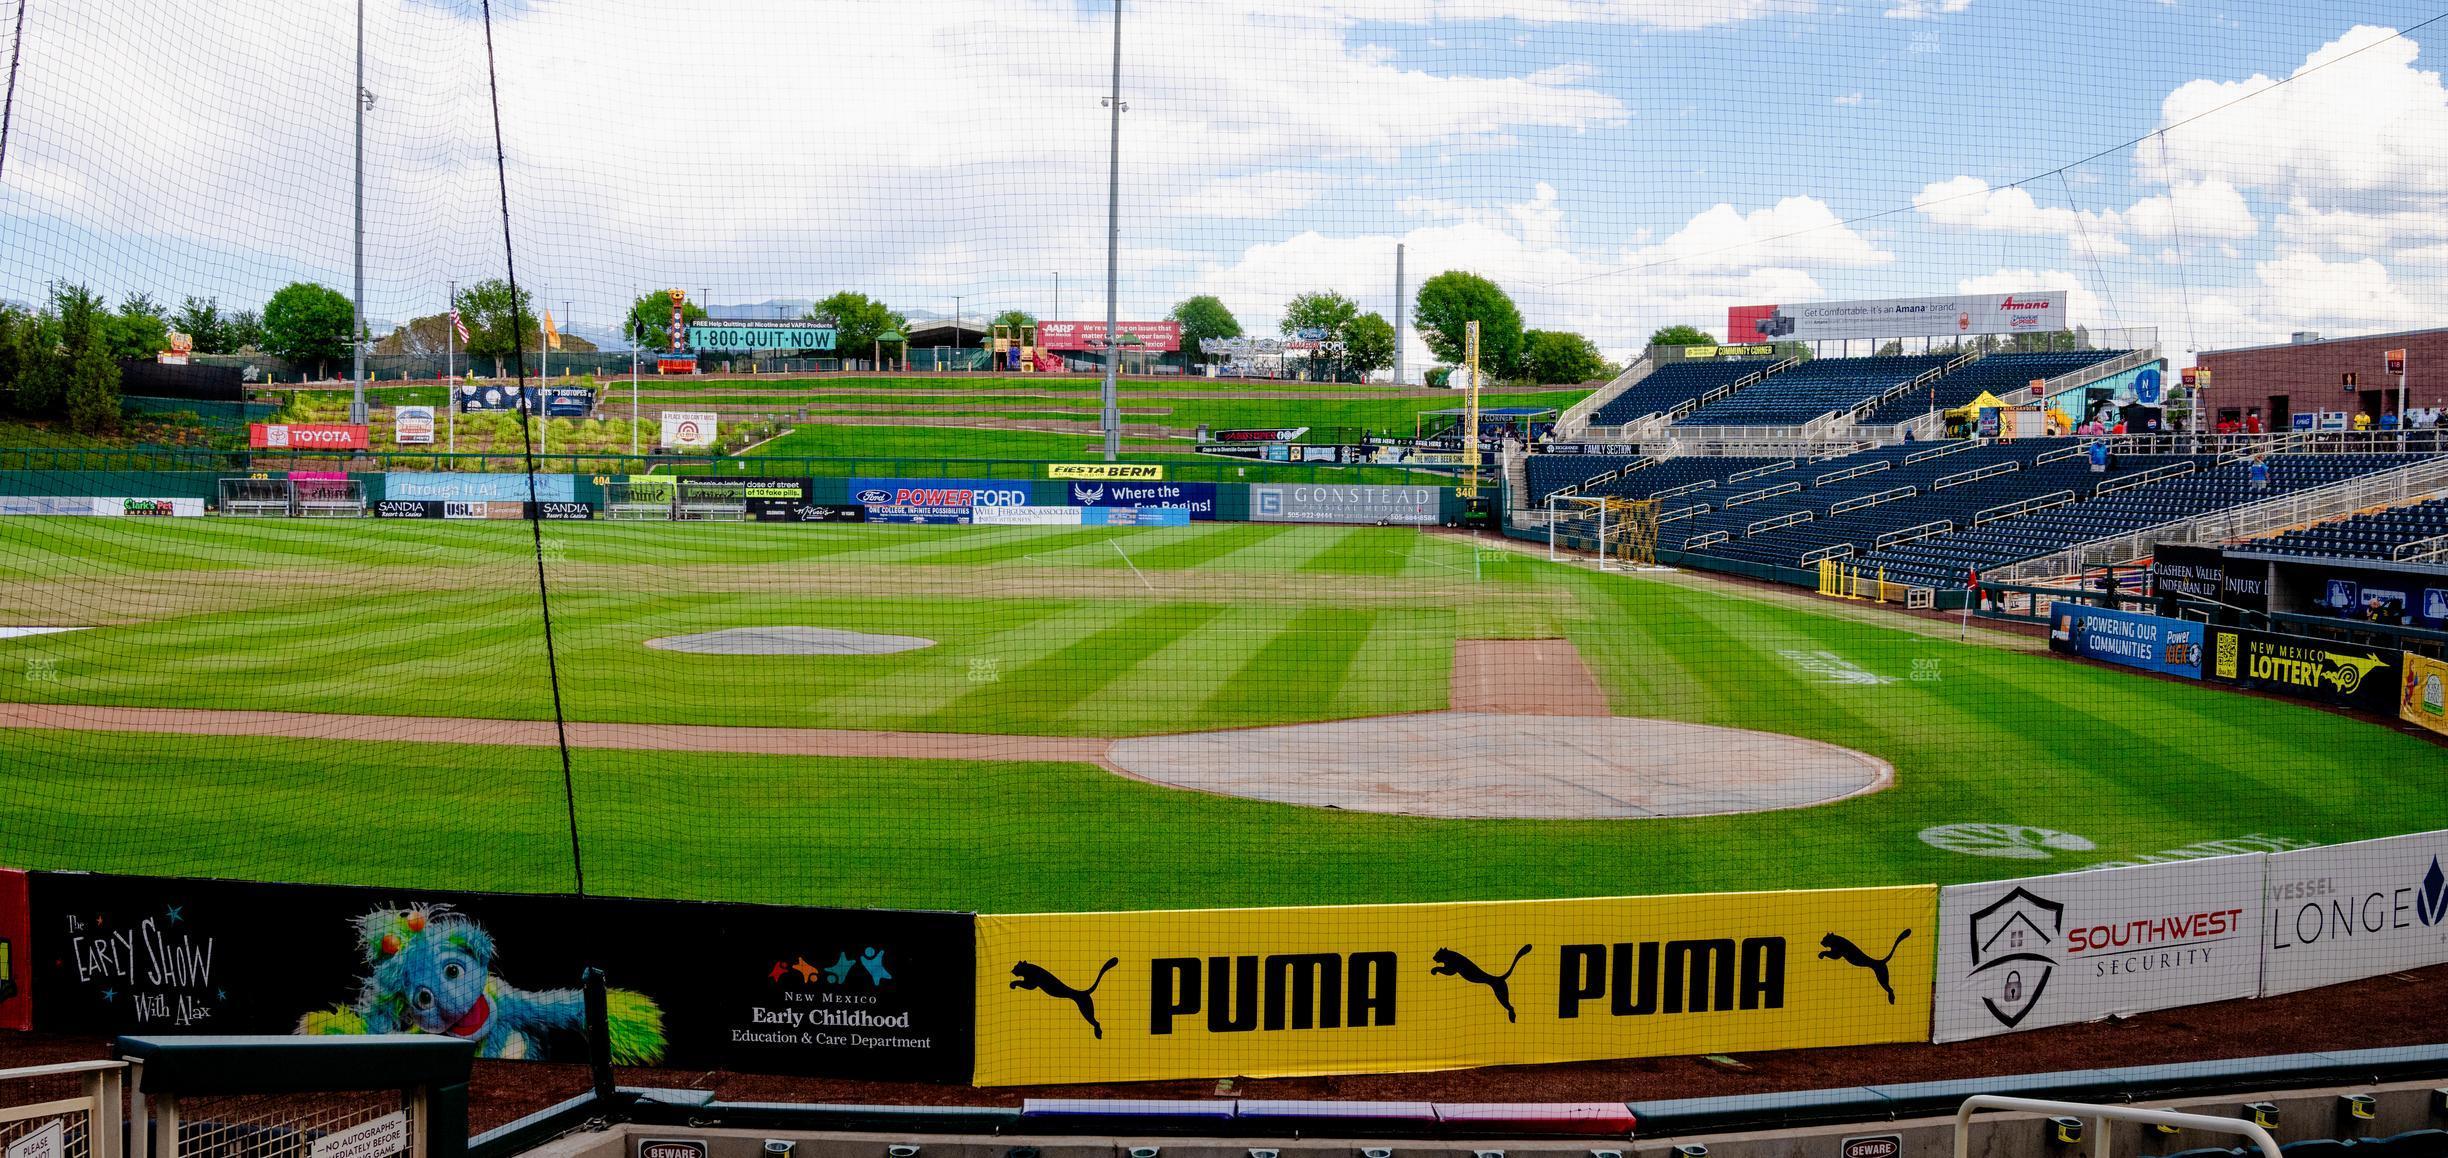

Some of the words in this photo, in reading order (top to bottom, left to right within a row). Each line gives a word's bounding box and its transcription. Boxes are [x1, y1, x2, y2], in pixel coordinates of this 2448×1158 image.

[1804, 309, 1817, 317] Get
[1819, 306, 1868, 317] Comfortable.
[1870, 305, 1882, 314] It's
[1884, 306, 1894, 314] an
[1930, 302, 1956, 312] brand.
[2000, 296, 2049, 310] Amana
[709, 320, 722, 328] Help
[723, 320, 746, 328] Quitting
[1042, 324, 1074, 333] AARP
[1084, 324, 1101, 332] We're
[1138, 324, 1156, 332] issues
[1158, 324, 1171, 332] that
[1320, 341, 1348, 350] FORD
[1718, 346, 1750, 355] COMMUNITY
[1750, 346, 1772, 355] CORNER
[2142, 379, 2149, 389] N
[1485, 414, 1513, 422] CORNER
[292, 431, 351, 442] TOYOTA
[1584, 444, 1606, 455] FAMILY
[1606, 444, 1631, 455] SECTION
[1414, 454, 1423, 463] THE
[1424, 454, 1439, 463] MODEL
[1440, 454, 1451, 463] BEER
[1108, 467, 1157, 477] BERM
[592, 476, 610, 486] 404
[747, 480, 766, 488] dose
[767, 480, 776, 488] of
[400, 483, 459, 497] Through
[464, 483, 473, 496] It
[479, 483, 499, 496] All
[862, 491, 885, 502] Ford
[896, 488, 973, 506] POWER
[973, 490, 1025, 507] FORD
[1112, 487, 1155, 500] Where
[1158, 485, 1180, 498] the
[1294, 487, 1429, 505] GONSTEAD
[1455, 488, 1474, 498] 340
[124, 499, 155, 509] Clark's
[157, 500, 173, 509] Pet
[379, 502, 424, 511] SANDIA
[543, 503, 589, 513] SANDIA
[974, 507, 993, 515] WILL
[998, 507, 1035, 516] FERGUSON
[2153, 562, 2194, 578] GLASHEEN,
[2196, 565, 2222, 581] VALLES
[2159, 577, 2202, 594] INDERMAN,
[2203, 583, 2216, 595] LLP
[2225, 576, 2261, 595] INJURY
[2087, 615, 2135, 637] POWERING
[2137, 623, 2157, 641] OUR
[2166, 630, 2190, 644] Power
[2089, 635, 2152, 660] COMMUNITIES
[2165, 643, 2188, 665] KICK
[2250, 641, 2274, 655] NEW
[2279, 645, 2324, 662] MEXICO
[2249, 654, 2323, 688] LOTTERY
[2271, 877, 2336, 902] VESSEL
[66, 914, 84, 934] The
[2067, 907, 2243, 953] SOUTHWEST
[73, 928, 135, 985] EARLY
[141, 917, 214, 988] SHOW
[2095, 947, 2214, 978] SECURITY
[1557, 936, 1787, 1019] PUMA
[784, 991, 815, 1002] NEW
[822, 993, 877, 1004] MEXICO
[1150, 951, 1398, 1035] PUMA
[134, 994, 169, 1023] With
[752, 1007, 803, 1028] Early
[809, 1009, 910, 1028] Childhood
[732, 1029, 797, 1044] Education
[801, 1032, 813, 1044] &
[816, 1033, 847, 1046] Care
[850, 1034, 931, 1048] Department
[325, 1141, 340, 1152] NO
[342, 1121, 395, 1147] AUTOGRAPHS
[373, 1130, 401, 1148] BEFORE
[23, 1137, 48, 1156] PLEASE
[373, 1143, 396, 1158] GAME
[651, 1148, 696, 1158] BEWARE
[1852, 1144, 1891, 1156] BEWARE
